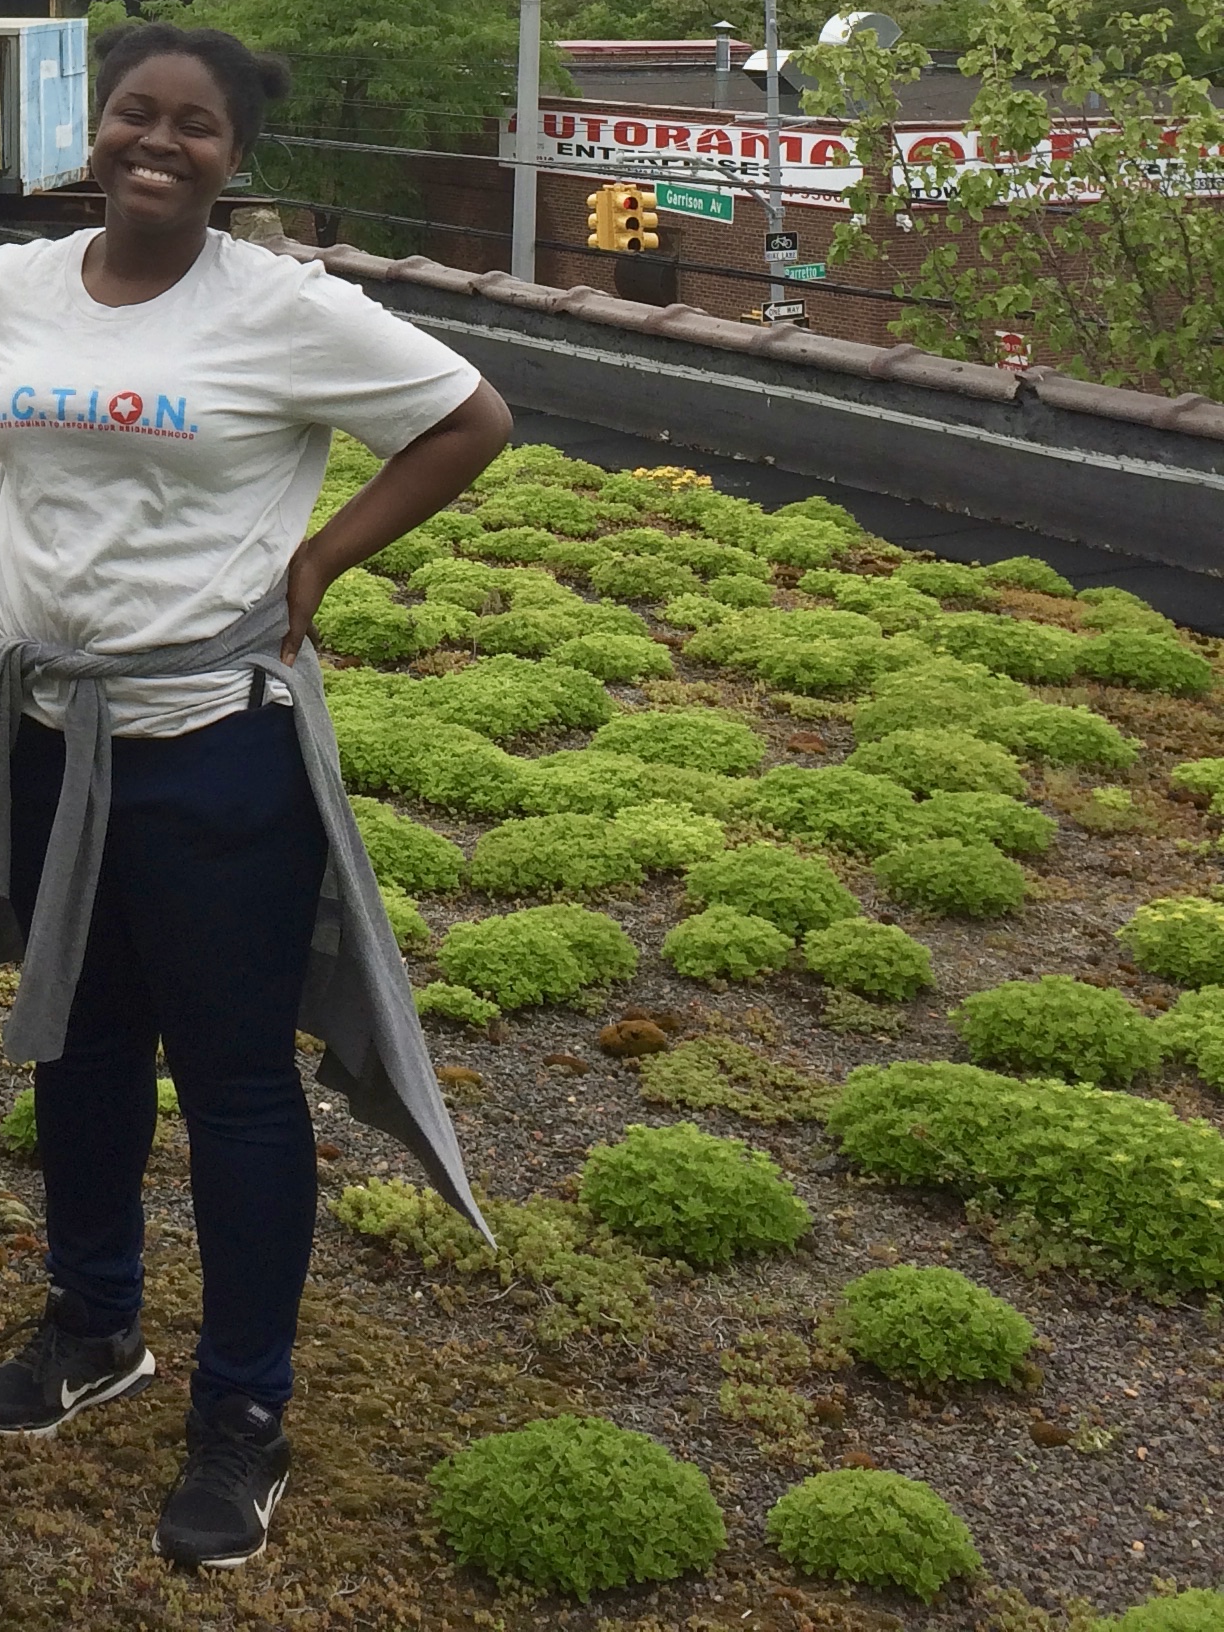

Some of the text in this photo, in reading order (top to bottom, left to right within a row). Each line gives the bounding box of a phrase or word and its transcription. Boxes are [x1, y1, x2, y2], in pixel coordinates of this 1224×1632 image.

[508, 112, 851, 165] UTORAMA
[557, 142, 783, 177] ENTSES
[666, 189, 723, 214] Garrison Av
[769, 306, 800, 316] ONE WAY
[97, 424, 115, 432] OUR
